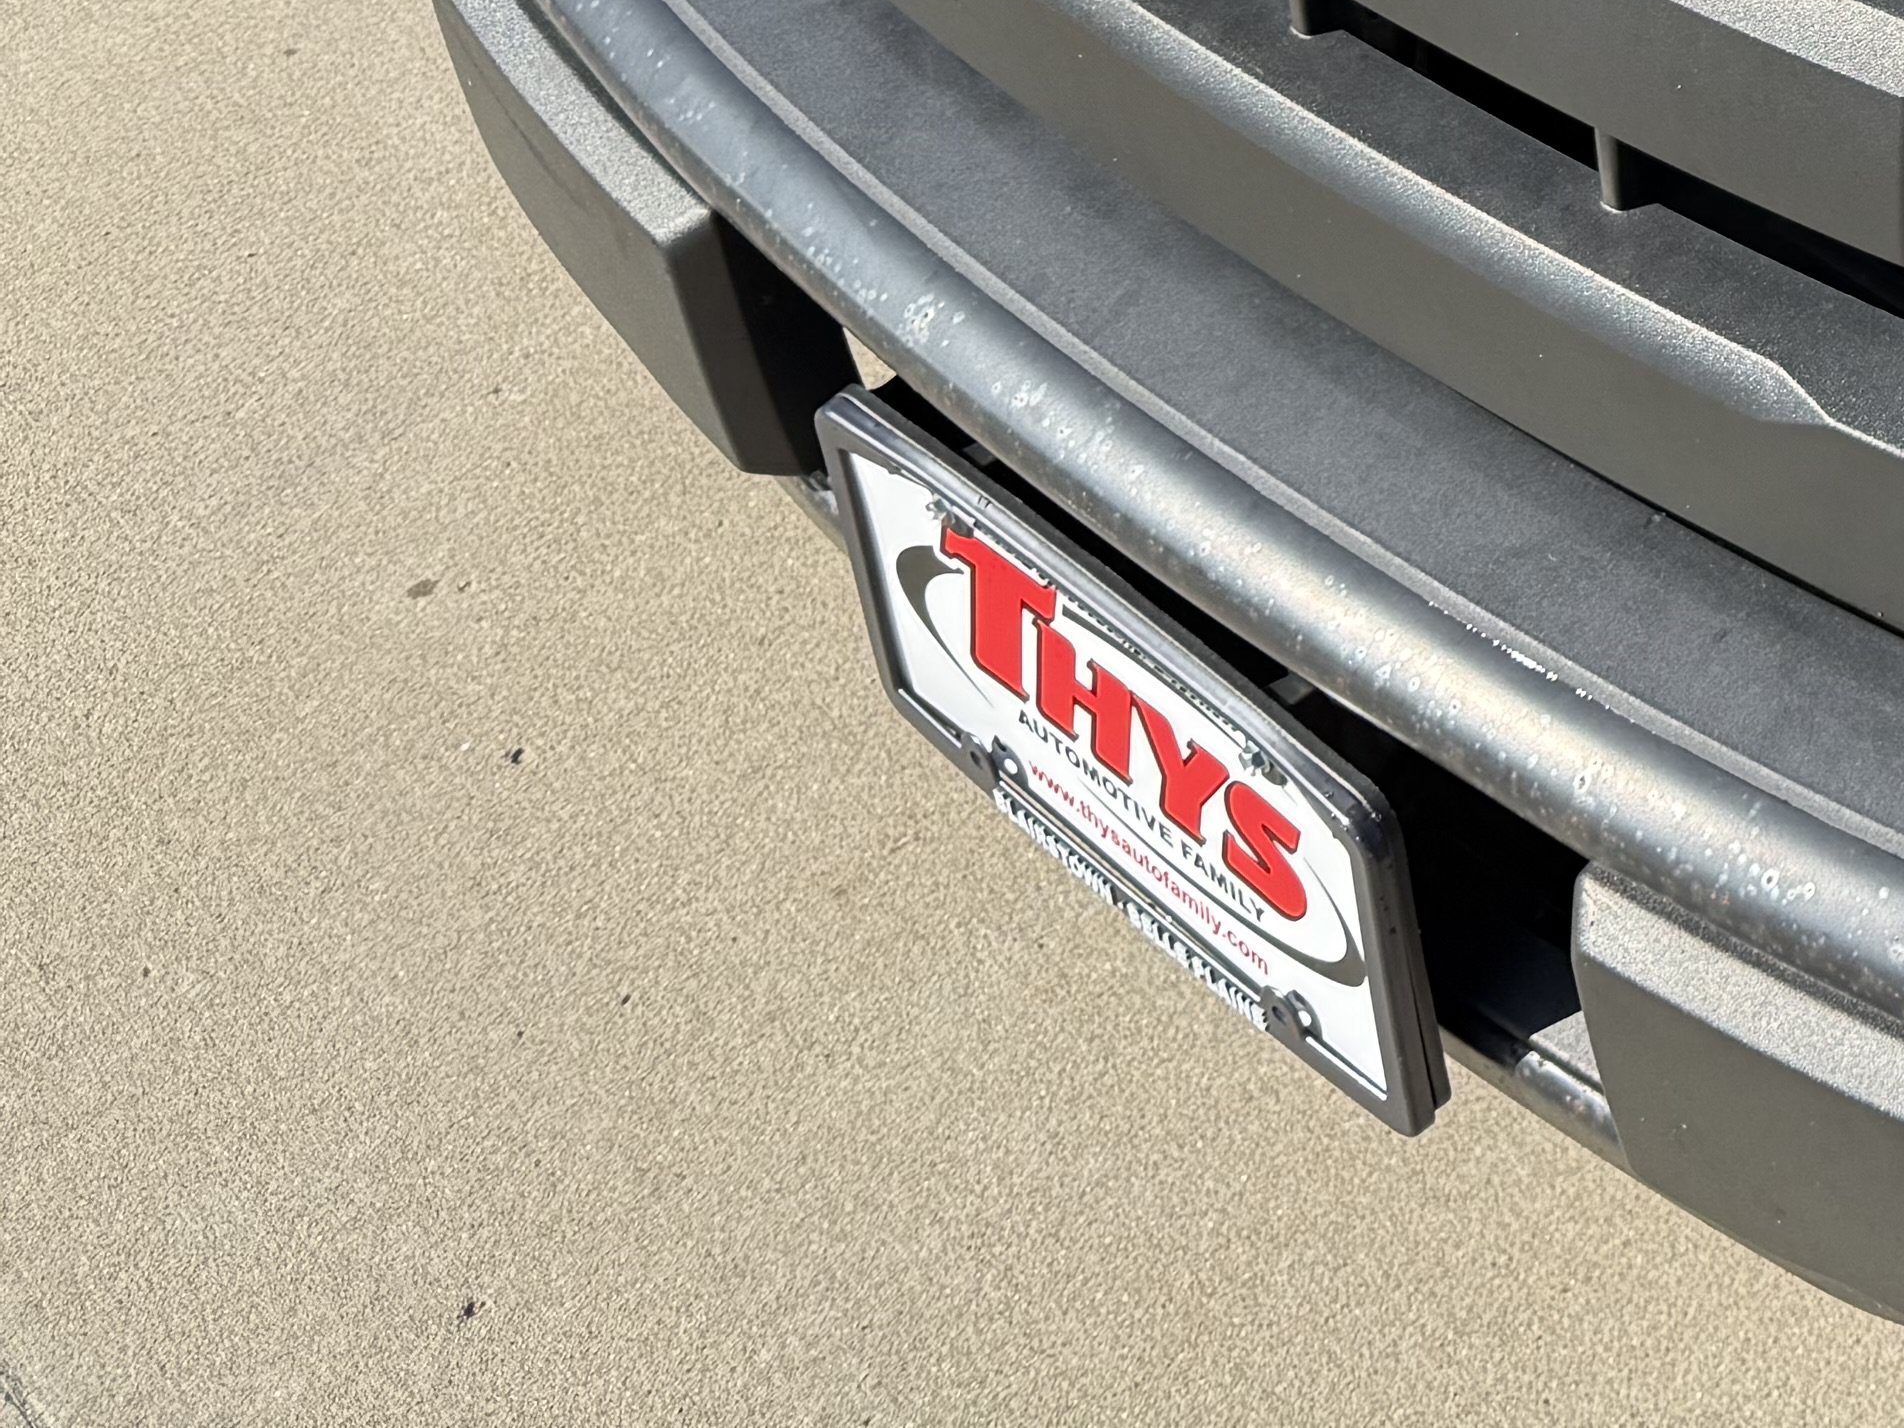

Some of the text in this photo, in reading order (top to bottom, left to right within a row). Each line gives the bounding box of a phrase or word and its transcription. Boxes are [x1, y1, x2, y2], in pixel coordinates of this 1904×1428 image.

[940, 526, 1308, 922] THYS
[1018, 709, 1265, 923] AUTOMOTIVE FAMILY
[1028, 759, 1269, 976] www.thysautofamily.com
